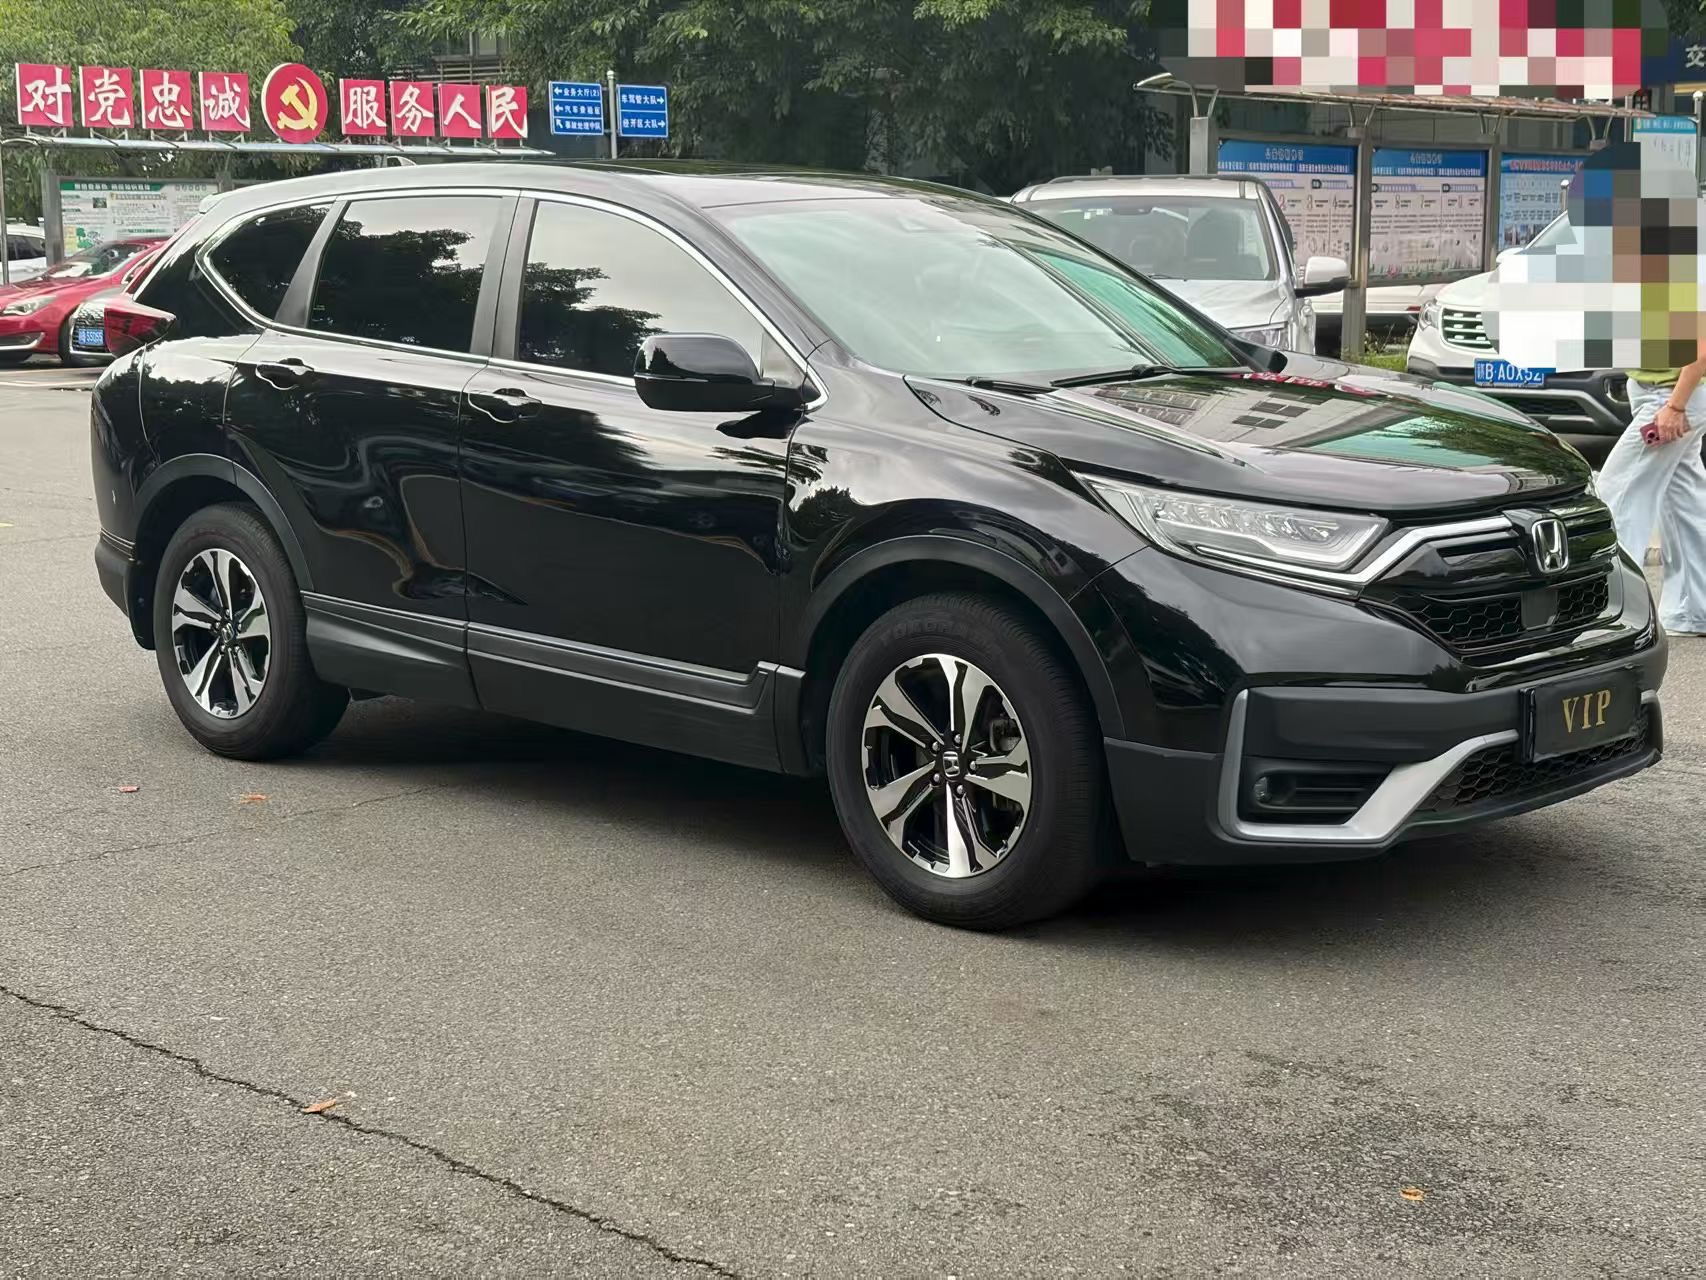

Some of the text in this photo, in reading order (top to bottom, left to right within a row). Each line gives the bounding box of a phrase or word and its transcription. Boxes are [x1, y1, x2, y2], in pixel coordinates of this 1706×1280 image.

[22, 67, 528, 139] 对党忠诚 服务人民
[1562, 689, 1611, 733] VIP
